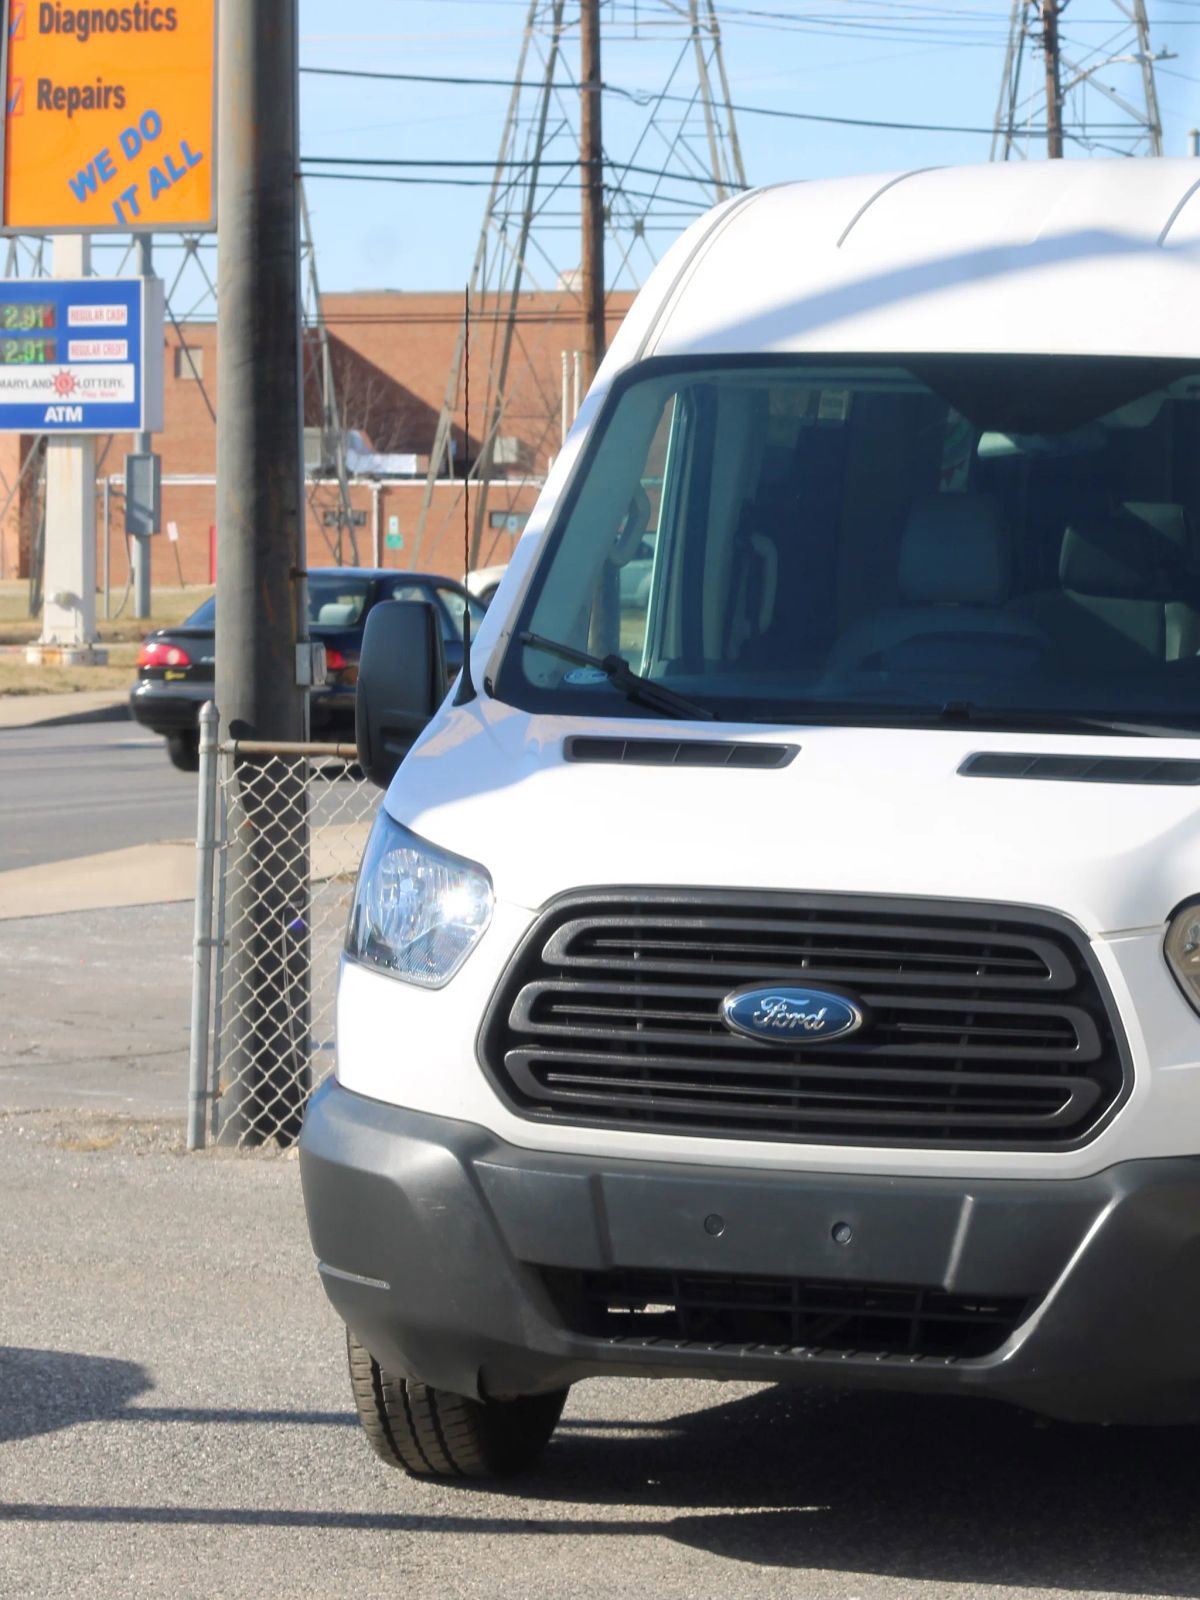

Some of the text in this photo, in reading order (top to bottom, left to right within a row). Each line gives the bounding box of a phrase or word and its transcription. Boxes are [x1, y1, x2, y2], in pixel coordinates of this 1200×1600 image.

[39, 0, 178, 42] Diagnostics
[37, 77, 126, 118] Repairs
[67, 109, 162, 203] WE DO
[112, 140, 203, 225] IT ALL
[44, 406, 83, 423] ATM
[753, 995, 828, 1030] Ford
